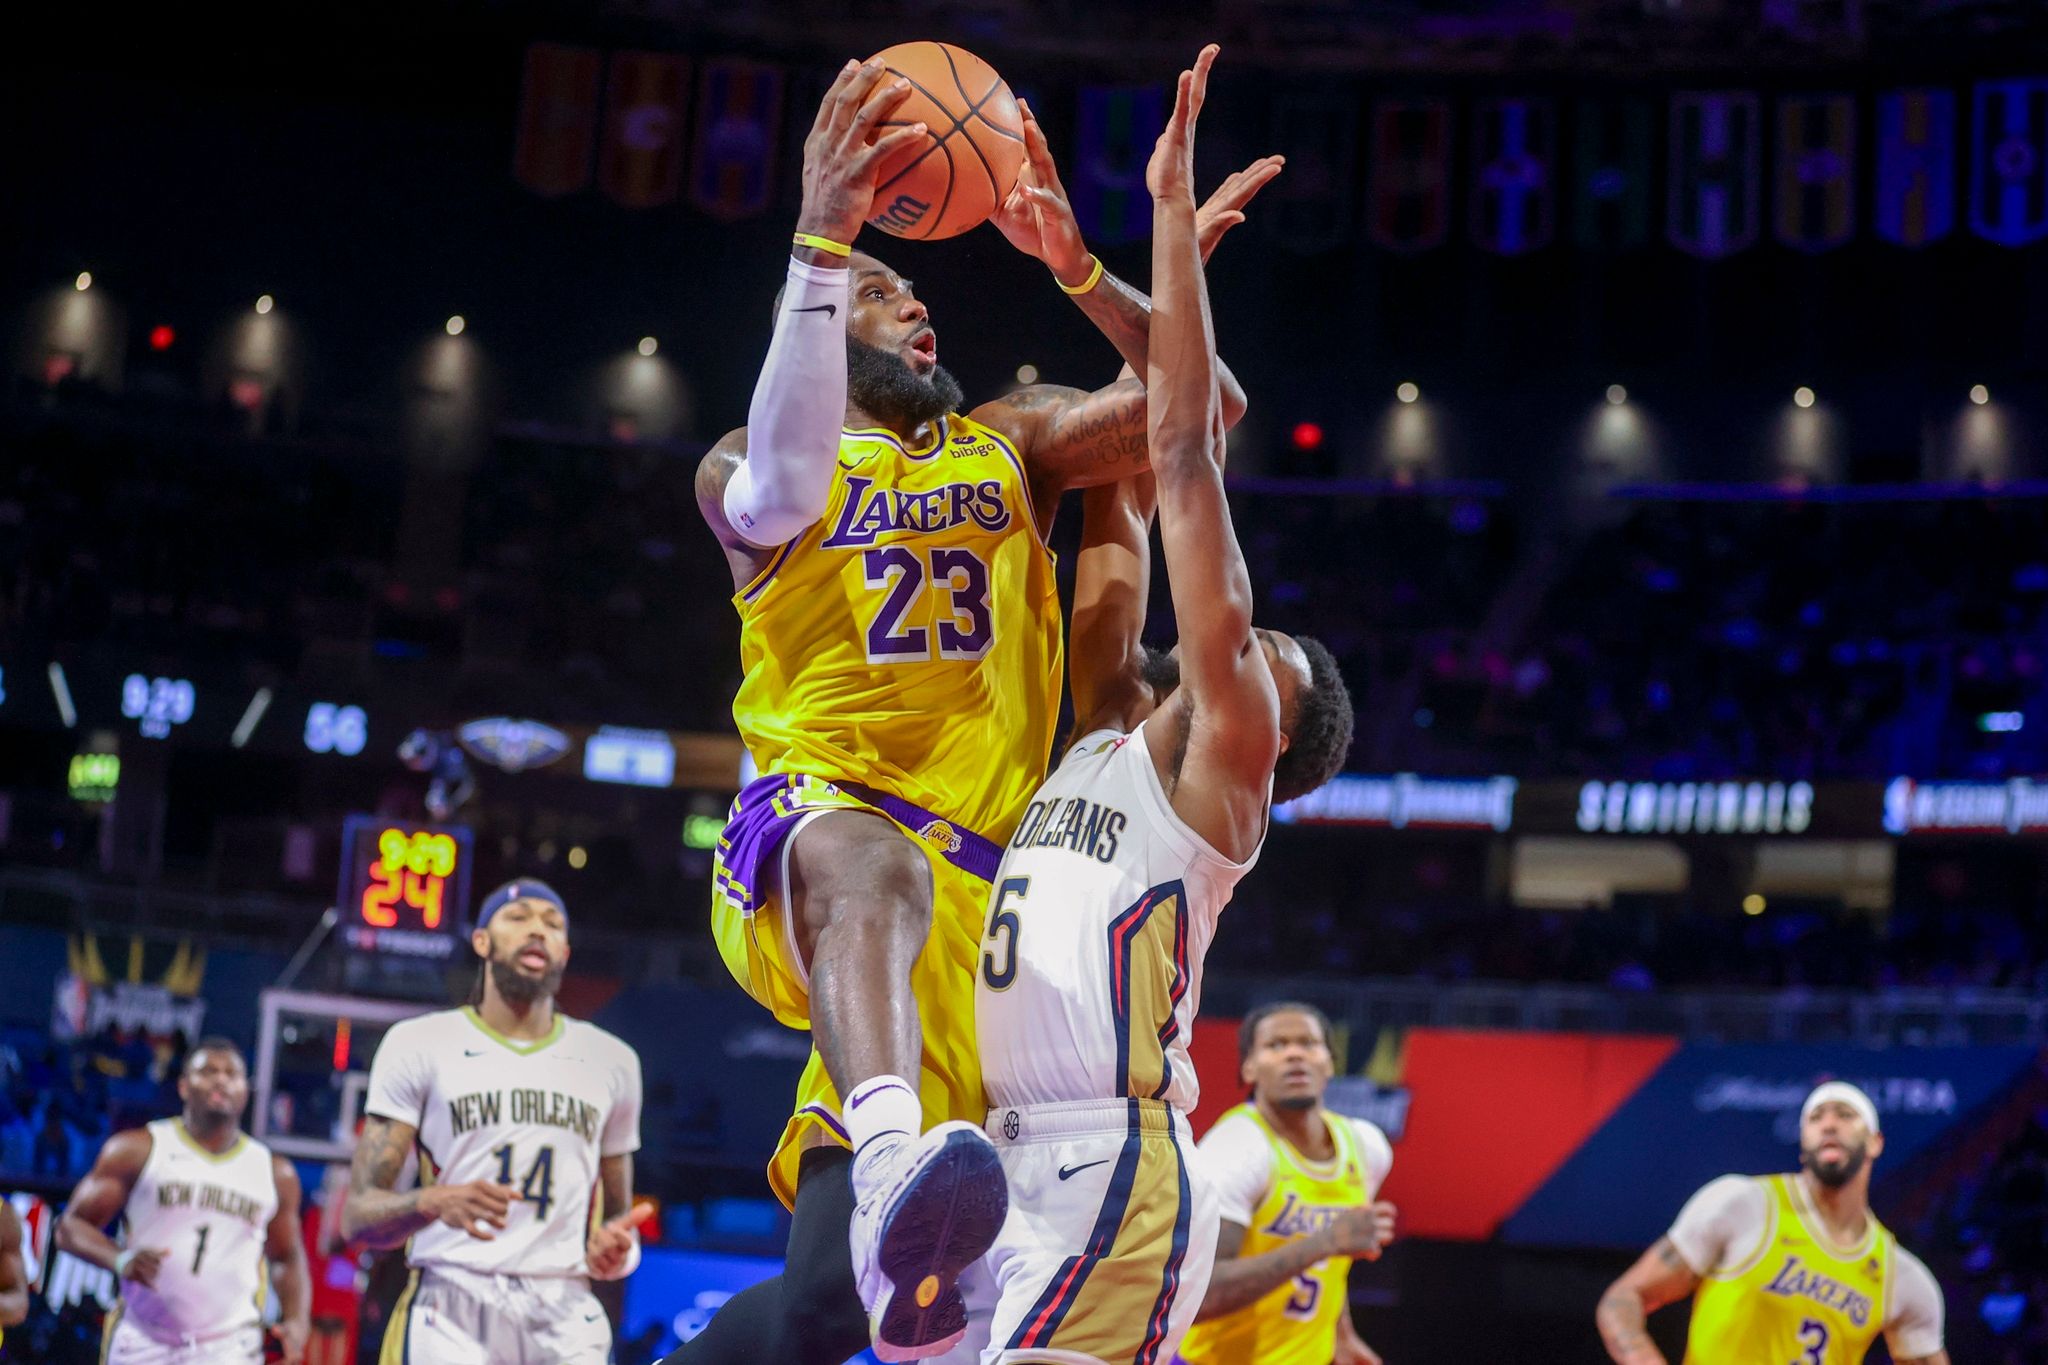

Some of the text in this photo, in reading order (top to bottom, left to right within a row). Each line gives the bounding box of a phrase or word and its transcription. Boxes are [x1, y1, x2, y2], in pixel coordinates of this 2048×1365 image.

[950, 443, 996, 458] bibigo
[820, 476, 1010, 550] LAKERS
[863, 545, 997, 664] 23
[303, 701, 369, 756] 56
[362, 861, 444, 929] 24
[983, 875, 1031, 992] 5
[449, 1088, 600, 1144] NEW ORLEANS
[158, 1182, 192, 1208] NEW
[493, 1143, 554, 1221] 14
[191, 1224, 210, 1275] 1
[1762, 1255, 1872, 1328] LAKERS
[1797, 1317, 1830, 1365] 3
